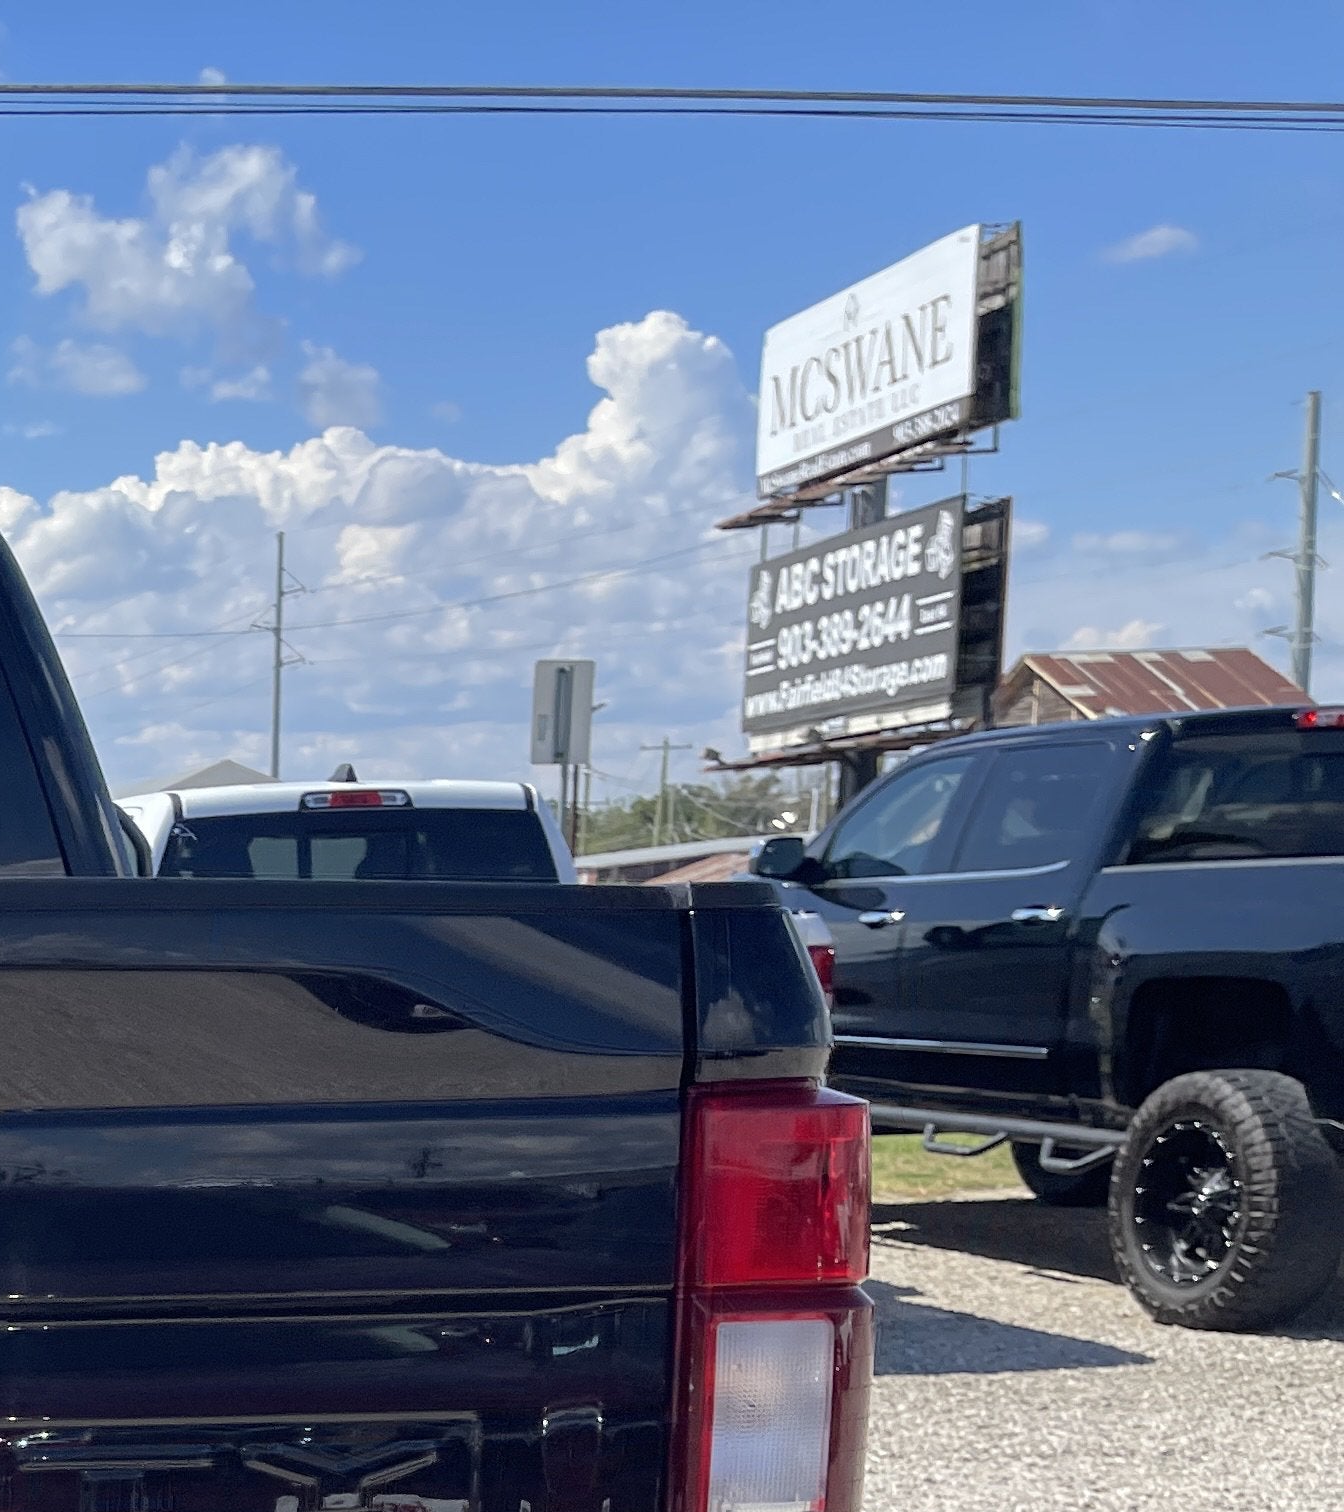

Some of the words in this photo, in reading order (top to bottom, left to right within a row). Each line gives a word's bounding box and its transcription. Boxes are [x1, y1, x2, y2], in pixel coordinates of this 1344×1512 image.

[769, 294, 953, 437] MCSWANE
[774, 557, 820, 614] ABC
[820, 523, 926, 601] STORAGE
[776, 592, 912, 670] 903-389-2644
